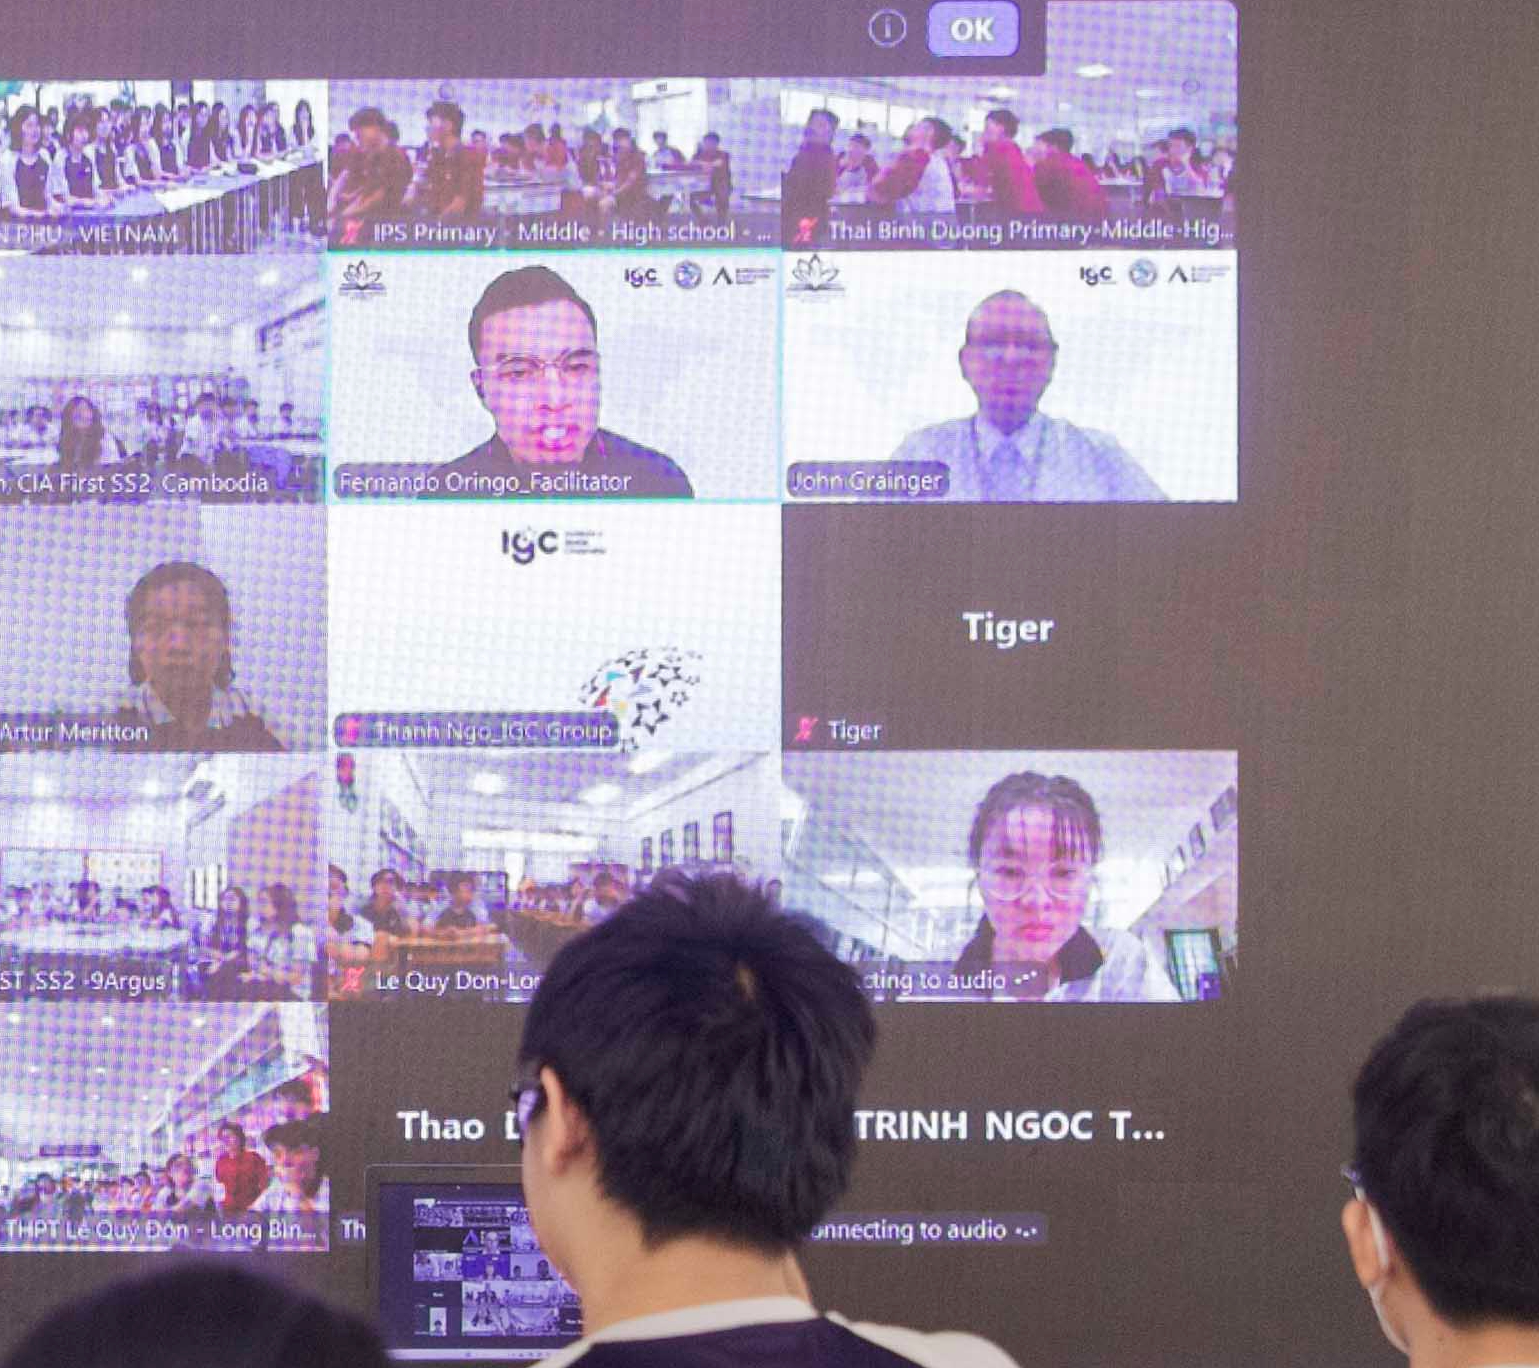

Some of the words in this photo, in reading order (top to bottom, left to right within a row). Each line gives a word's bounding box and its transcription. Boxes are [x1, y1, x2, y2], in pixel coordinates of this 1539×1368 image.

[950, 17, 994, 42] OK
[80, 224, 178, 244] VIETNAM
[374, 224, 408, 242] IPS
[415, 223, 496, 247] Primary
[519, 223, 591, 242] Middle
[612, 223, 662, 247] High
[668, 222, 736, 242] school
[828, 220, 872, 240] Thai
[932, 220, 1002, 245] Duong
[18, 474, 55, 493] CIA
[60, 473, 106, 493] First
[162, 472, 269, 493] Cambodia
[339, 471, 440, 492] Fernando
[445, 470, 632, 496] Oringo_Facilitator
[793, 470, 844, 491] John
[850, 470, 944, 496] Grainger
[962, 611, 1055, 648] Tiger
[60, 721, 149, 742] Meritton
[376, 721, 440, 740] Thanh
[546, 721, 613, 746] Group
[828, 720, 882, 745] Tiger
[377, 970, 400, 991] Le
[405, 970, 450, 996] Quy
[920, 971, 941, 990] to
[947, 969, 1006, 990] audio
[396, 1109, 485, 1141] Thao
[853, 1109, 969, 1141] TRINH
[985, 1109, 1093, 1141] NGOC
[5, 1219, 60, 1239] THPT
[210, 1218, 262, 1244] Long
[919, 1220, 942, 1240] to
[947, 1219, 1008, 1240] audio
